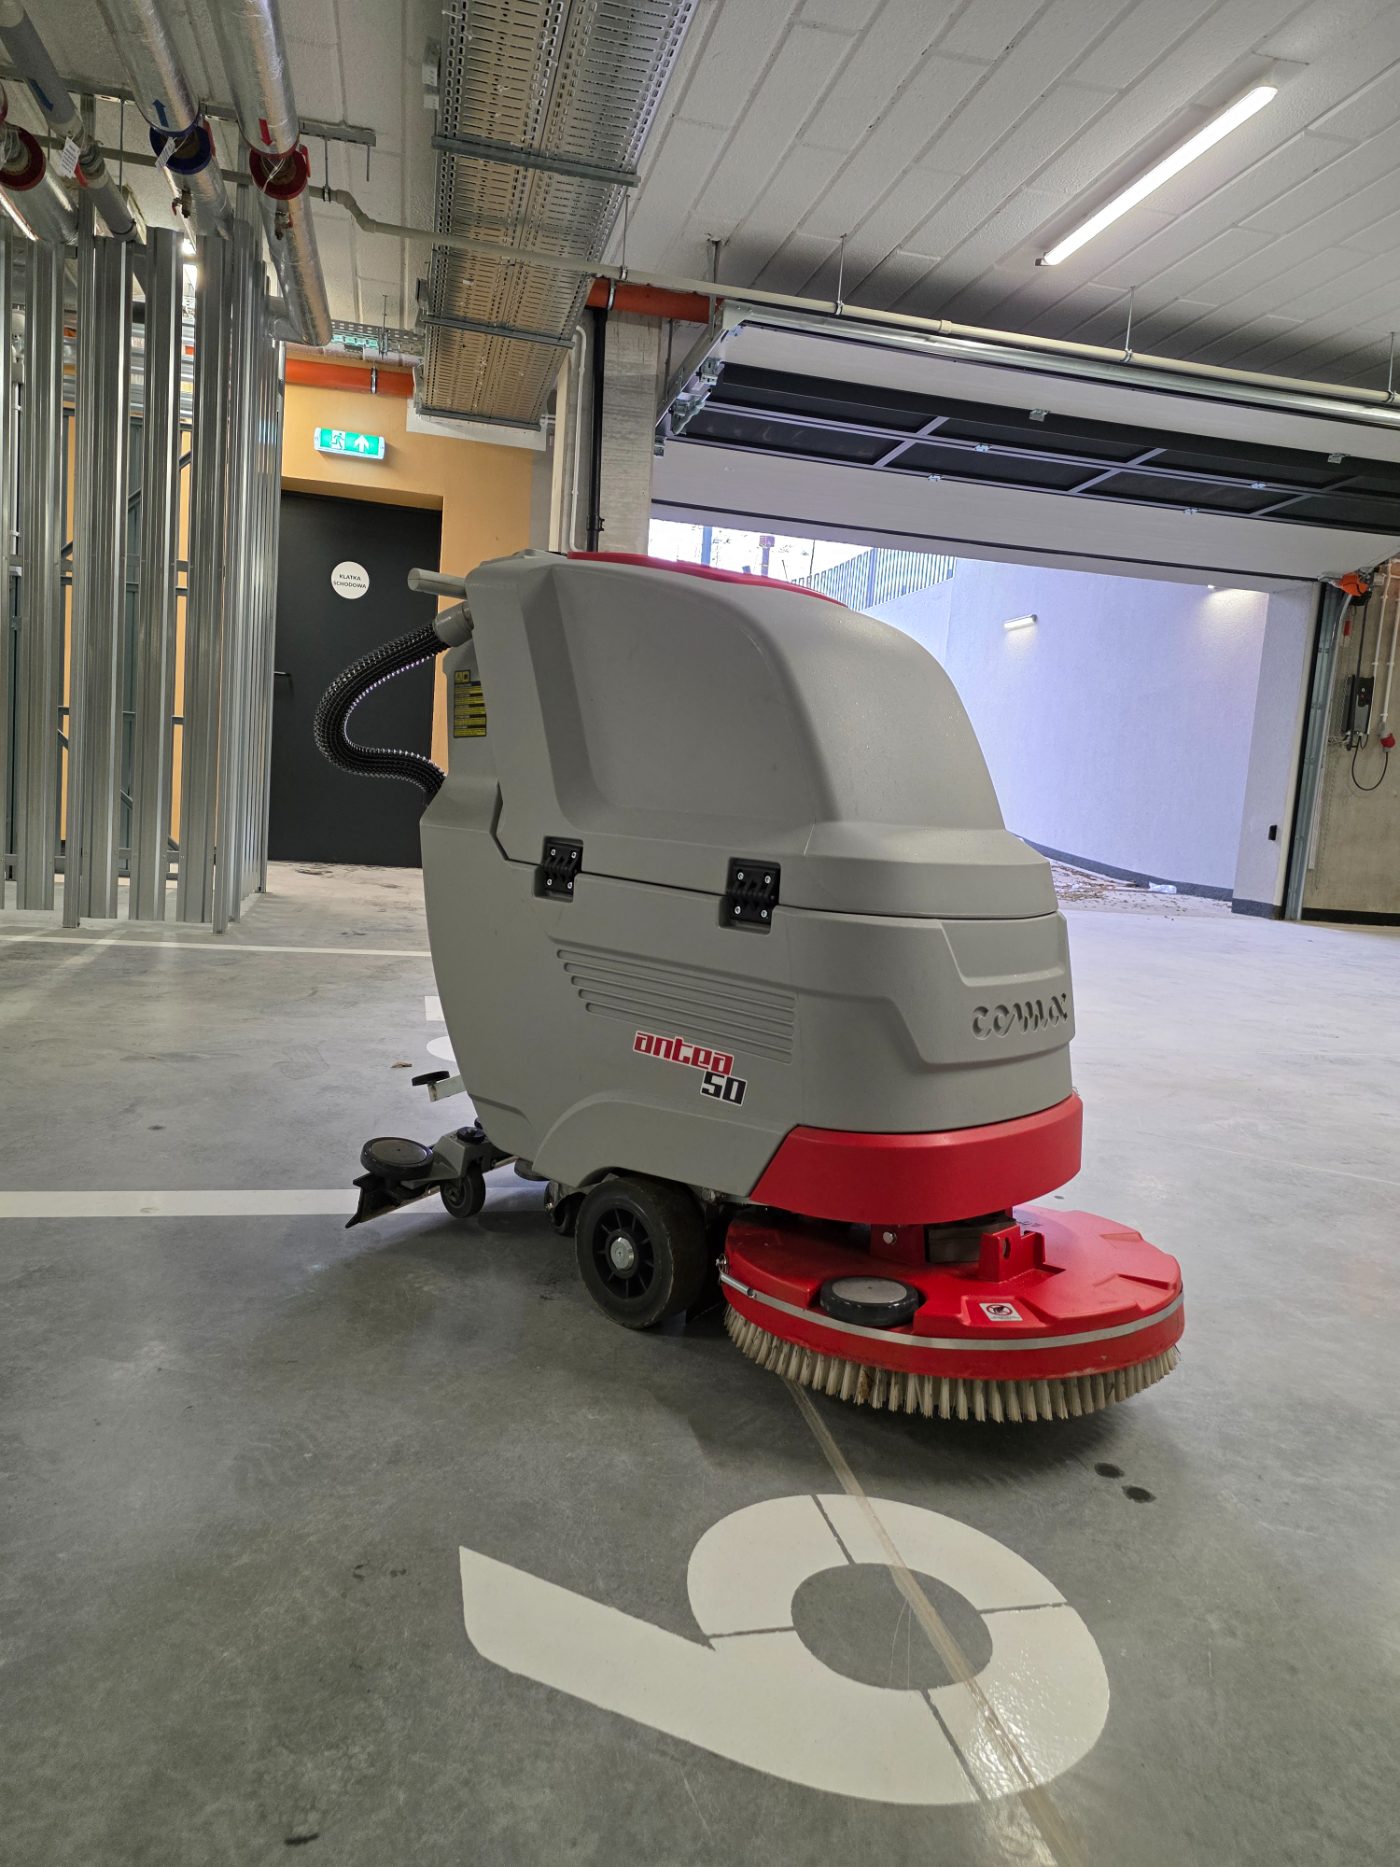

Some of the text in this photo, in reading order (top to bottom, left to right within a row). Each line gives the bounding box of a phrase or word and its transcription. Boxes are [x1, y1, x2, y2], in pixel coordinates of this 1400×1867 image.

[334, 581, 366, 589] SCHODOWA
[634, 1031, 734, 1076] antea
[701, 1070, 747, 1105] 50
